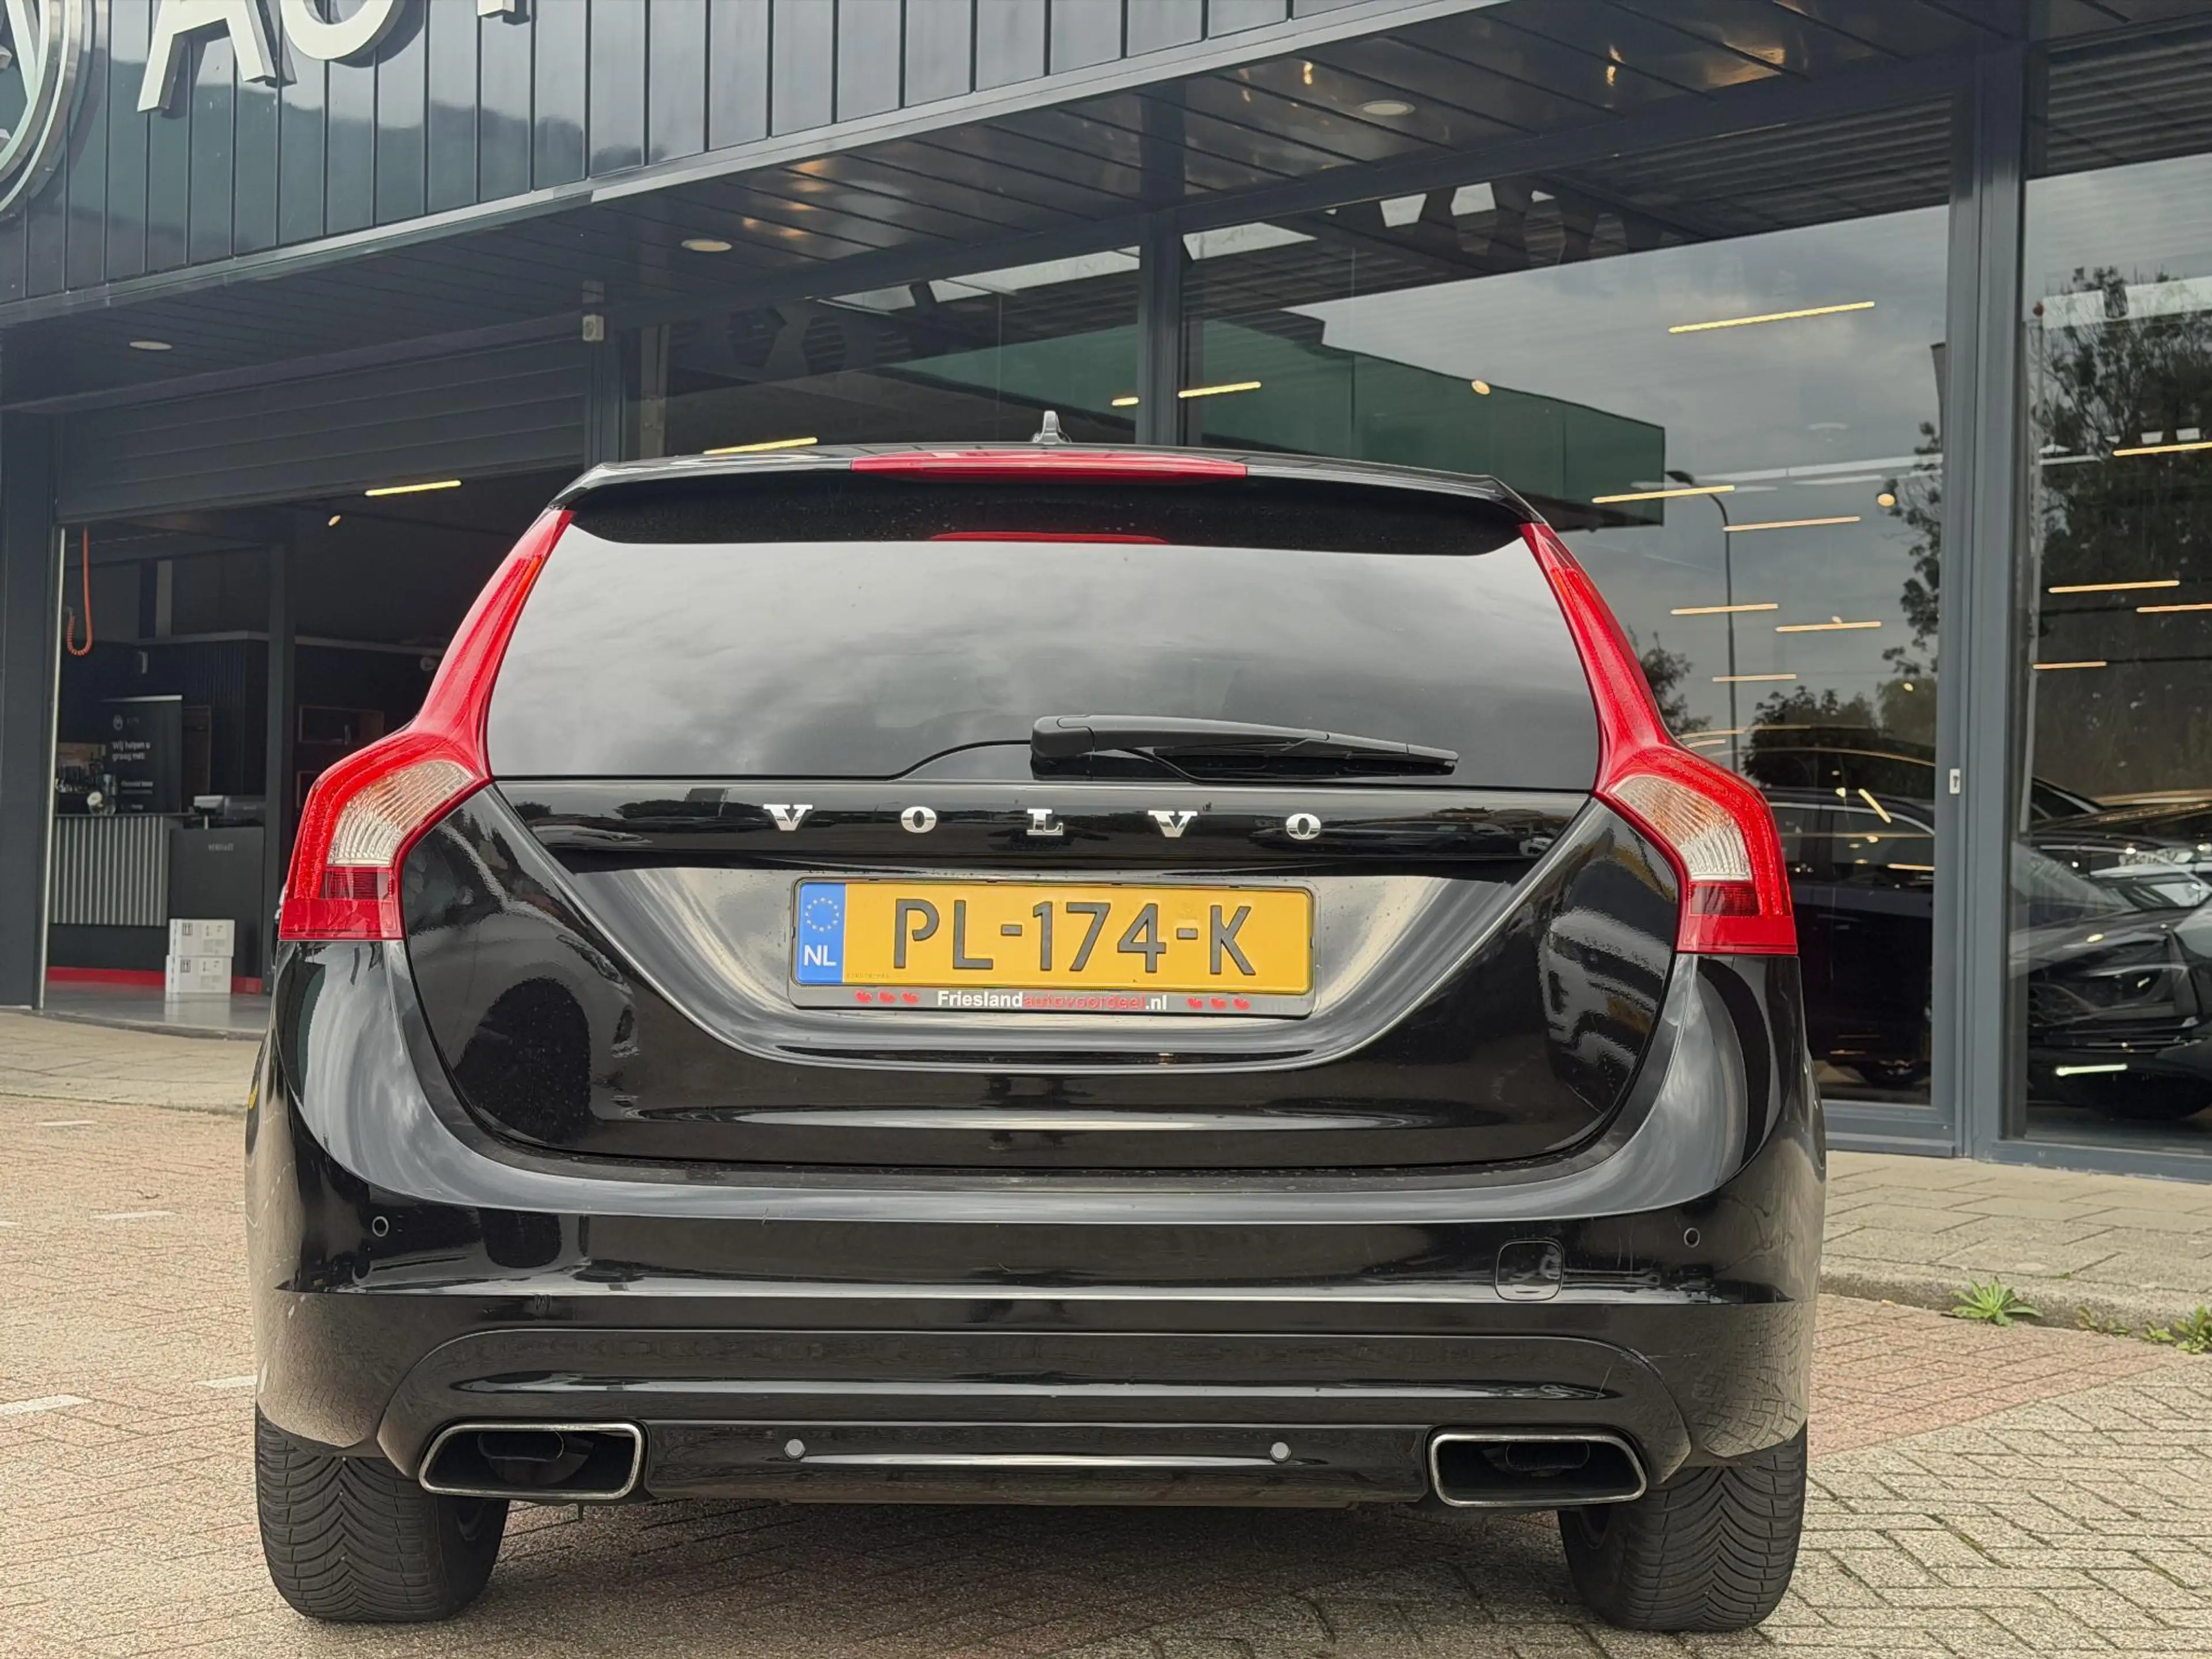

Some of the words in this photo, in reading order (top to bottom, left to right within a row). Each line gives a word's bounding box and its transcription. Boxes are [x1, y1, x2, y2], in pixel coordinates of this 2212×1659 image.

[763, 804, 1321, 840] VOLVO
[893, 899, 1256, 975] PL-174-K
[804, 944, 837, 967] NL
[937, 990, 1167, 1010] Frieslandautovoordeel.nl
